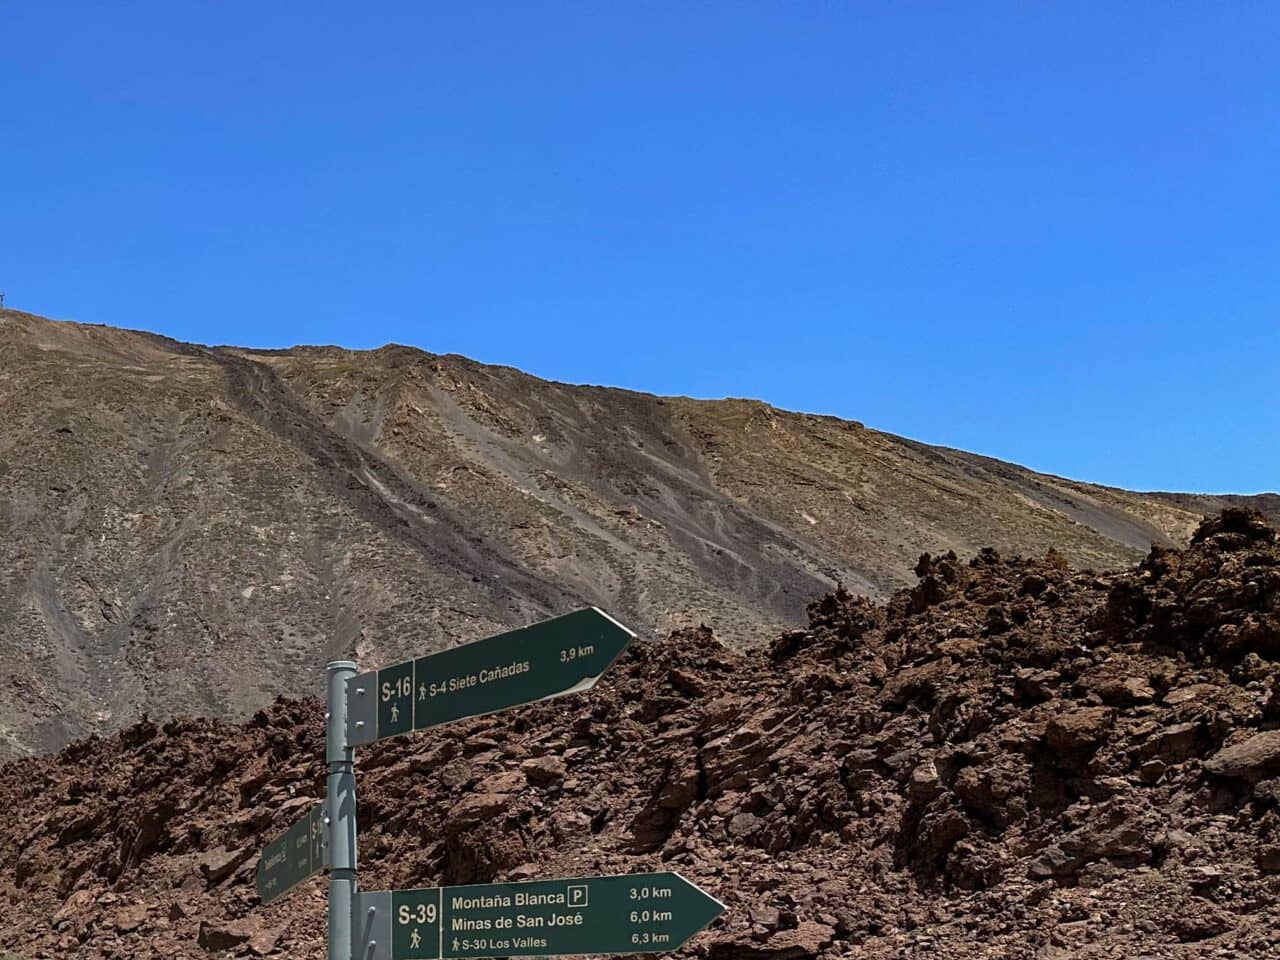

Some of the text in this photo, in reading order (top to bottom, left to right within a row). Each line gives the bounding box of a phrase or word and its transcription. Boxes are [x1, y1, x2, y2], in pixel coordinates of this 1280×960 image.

[560, 645, 594, 663] 3,9 km
[382, 676, 411, 701] S-16
[429, 661, 530, 697] S-4 Siete Cañadas
[452, 893, 511, 911] Montaña
[515, 891, 565, 907] Blanca
[630, 886, 671, 901] 3,0 km
[398, 904, 437, 924] S-39
[452, 911, 583, 931] Minas de San José
[630, 909, 671, 925] 6,0 km
[462, 936, 547, 950] S-30 Los Valles
[631, 932, 670, 946] 6,3 km
